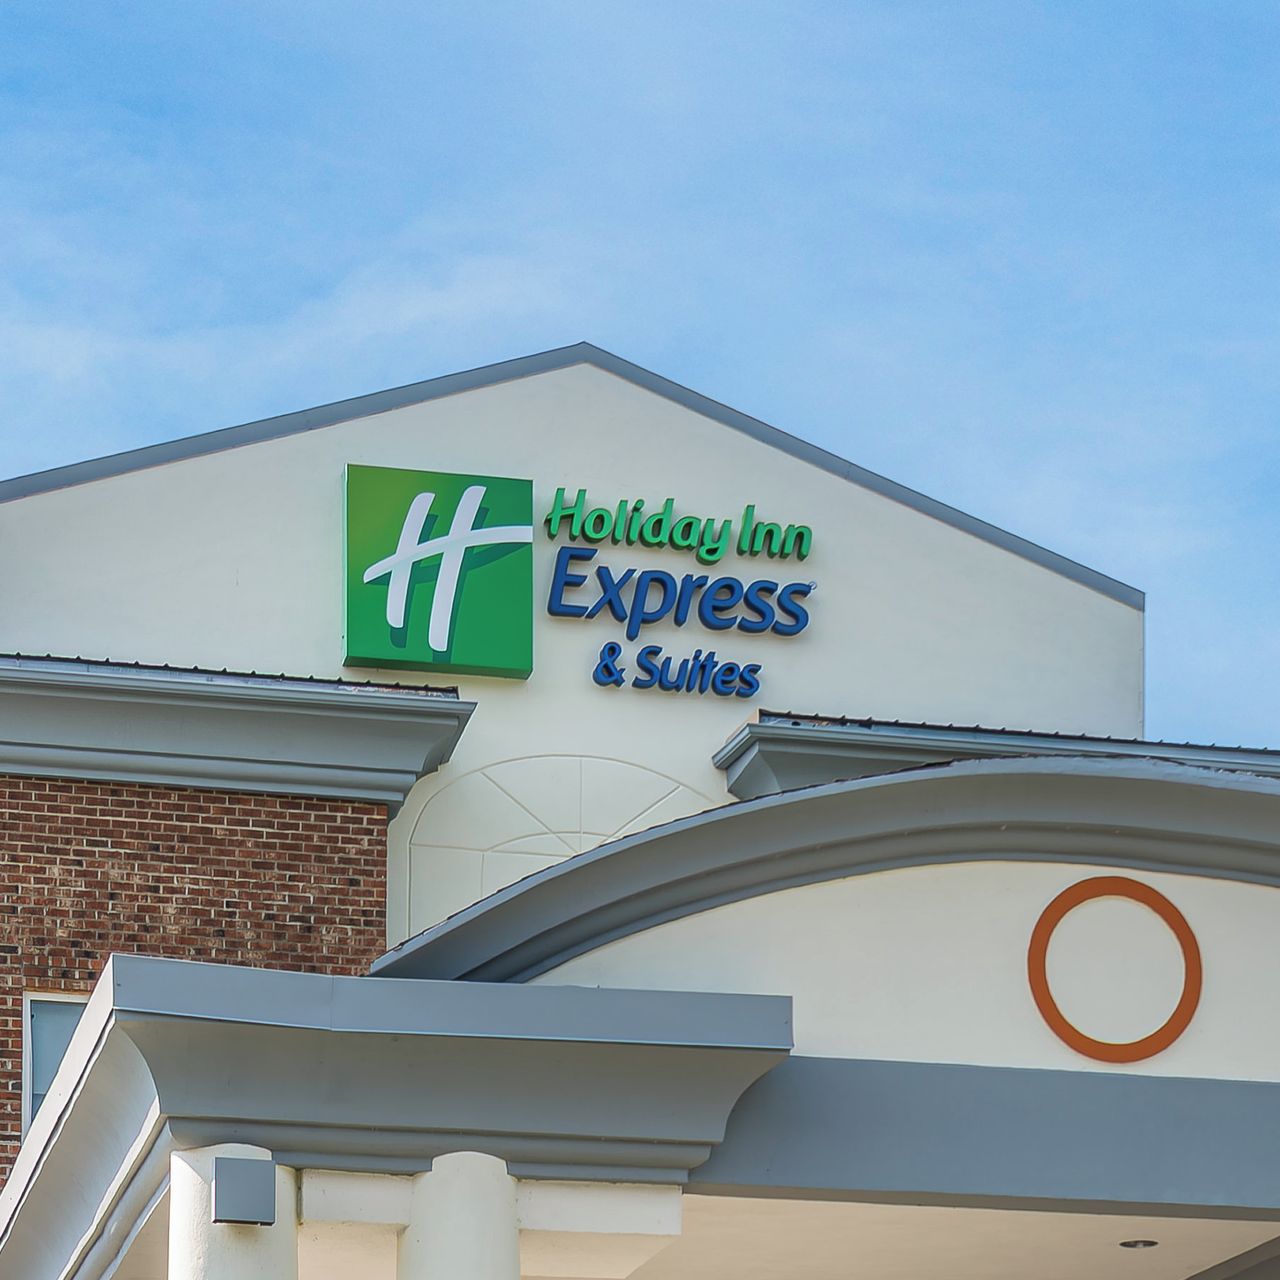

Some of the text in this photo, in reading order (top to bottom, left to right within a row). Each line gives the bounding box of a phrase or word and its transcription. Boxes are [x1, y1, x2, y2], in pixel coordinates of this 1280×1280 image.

[363, 485, 533, 652] H
[544, 487, 813, 565] Holiday Inn
[547, 546, 813, 641] Express
[592, 641, 762, 698] & Suites
